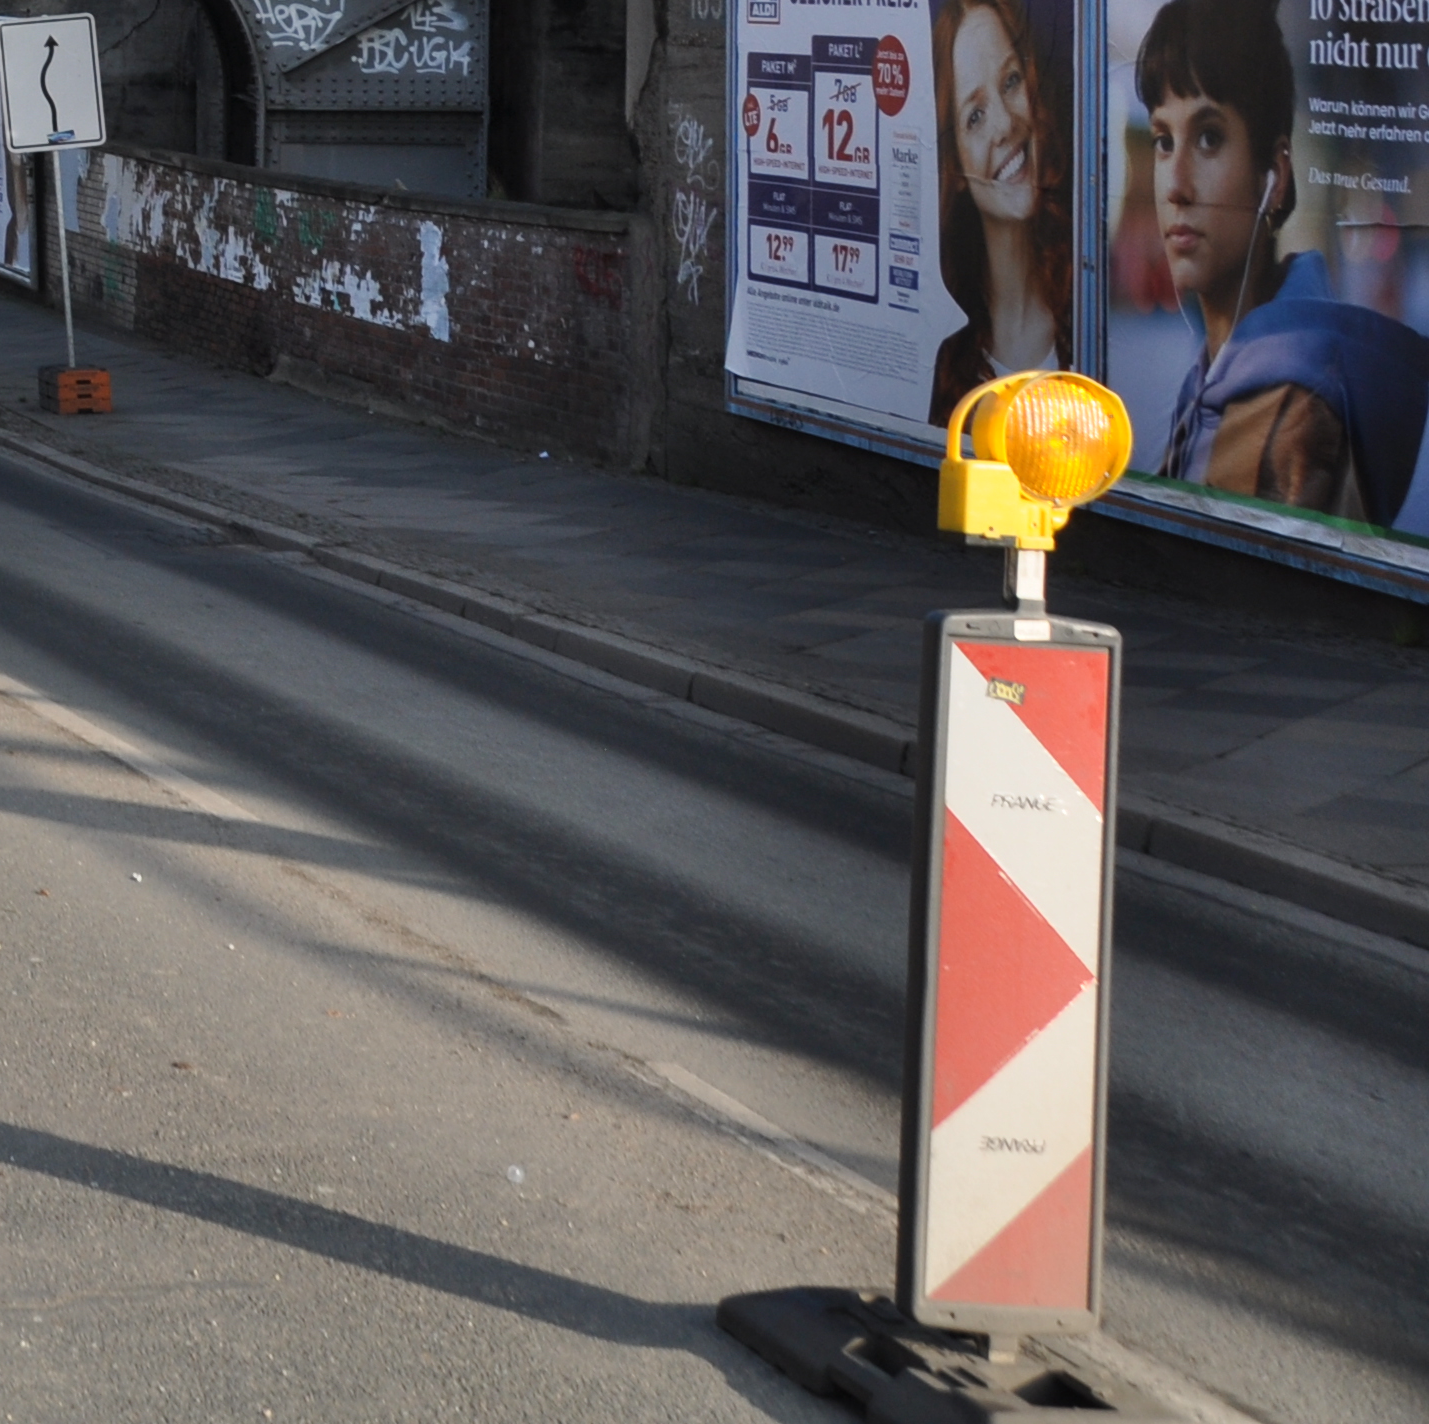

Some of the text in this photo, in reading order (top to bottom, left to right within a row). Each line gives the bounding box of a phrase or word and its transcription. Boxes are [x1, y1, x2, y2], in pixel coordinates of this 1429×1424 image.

[752, 3, 775, 17] ALDI
[828, 43, 854, 58] PAKET
[1309, 31, 1423, 70] nicht nur
[761, 59, 786, 74] PAKET
[877, 62, 891, 84] 70
[1351, 100, 1396, 118] können
[1397, 102, 1416, 118] wir
[744, 111, 758, 127] LTE
[1308, 119, 1336, 135] Jetzt
[1369, 124, 1421, 142] erfahren
[1308, 167, 1331, 185] Das
[1361, 173, 1412, 193] Gesund.
[773, 191, 786, 201] FLAT
[839, 201, 852, 211] FLAT
